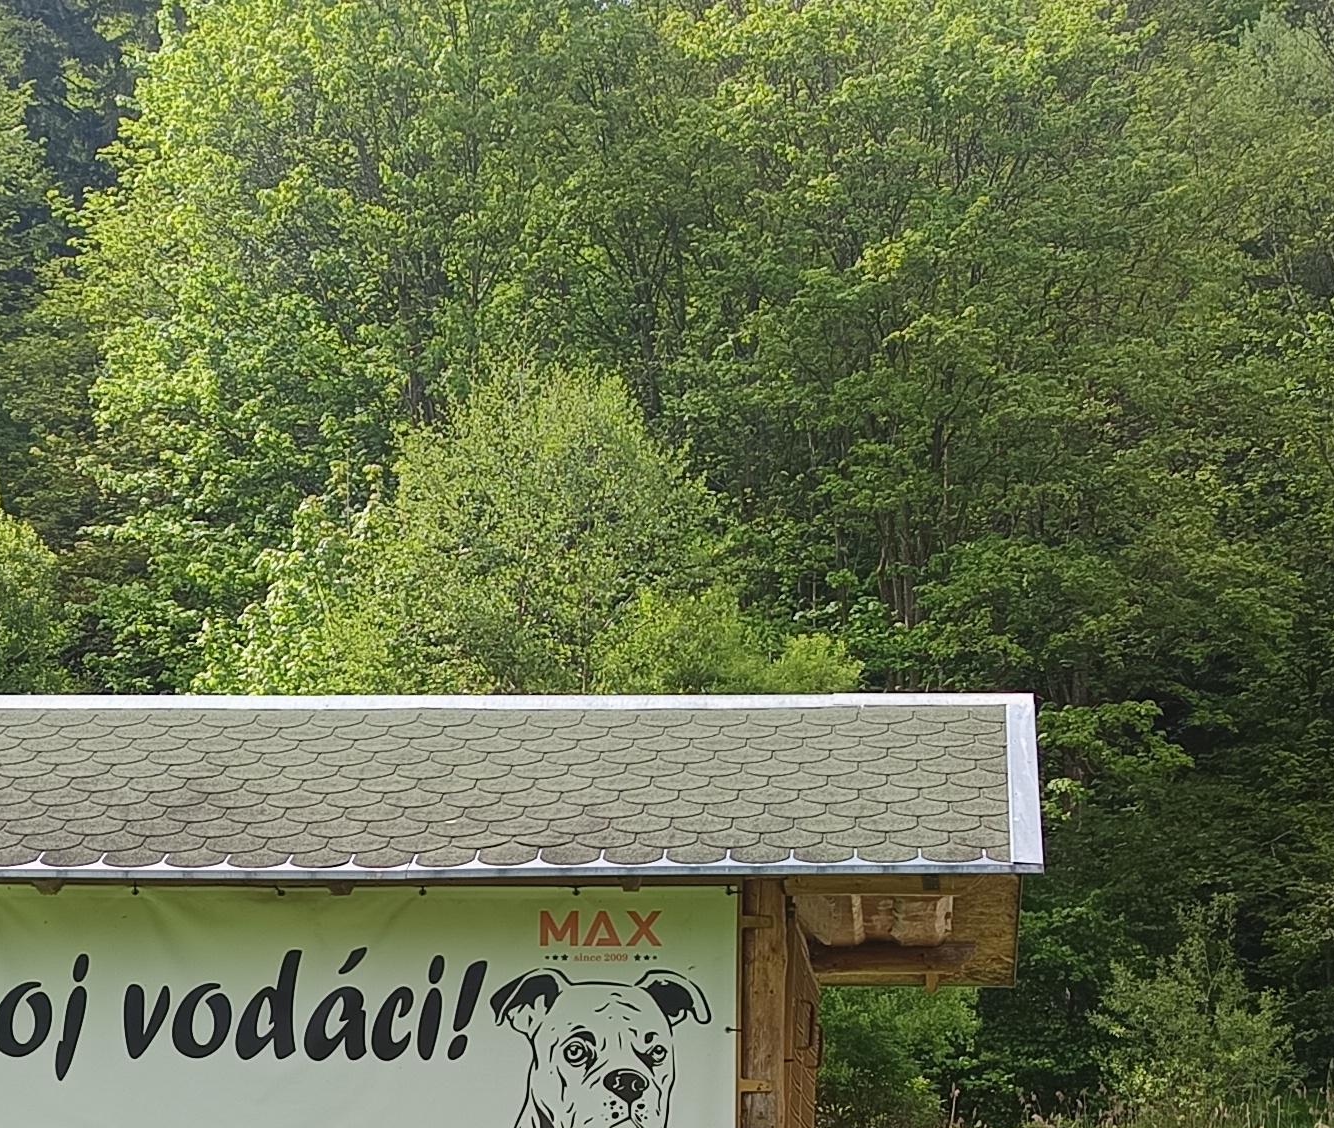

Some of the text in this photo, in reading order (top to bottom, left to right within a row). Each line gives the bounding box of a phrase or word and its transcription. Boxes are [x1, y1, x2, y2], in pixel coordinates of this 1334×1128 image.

[539, 910, 662, 947] MAX
[573, 951, 629, 963] since 2009
[123, 946, 488, 1062] vodáci!
